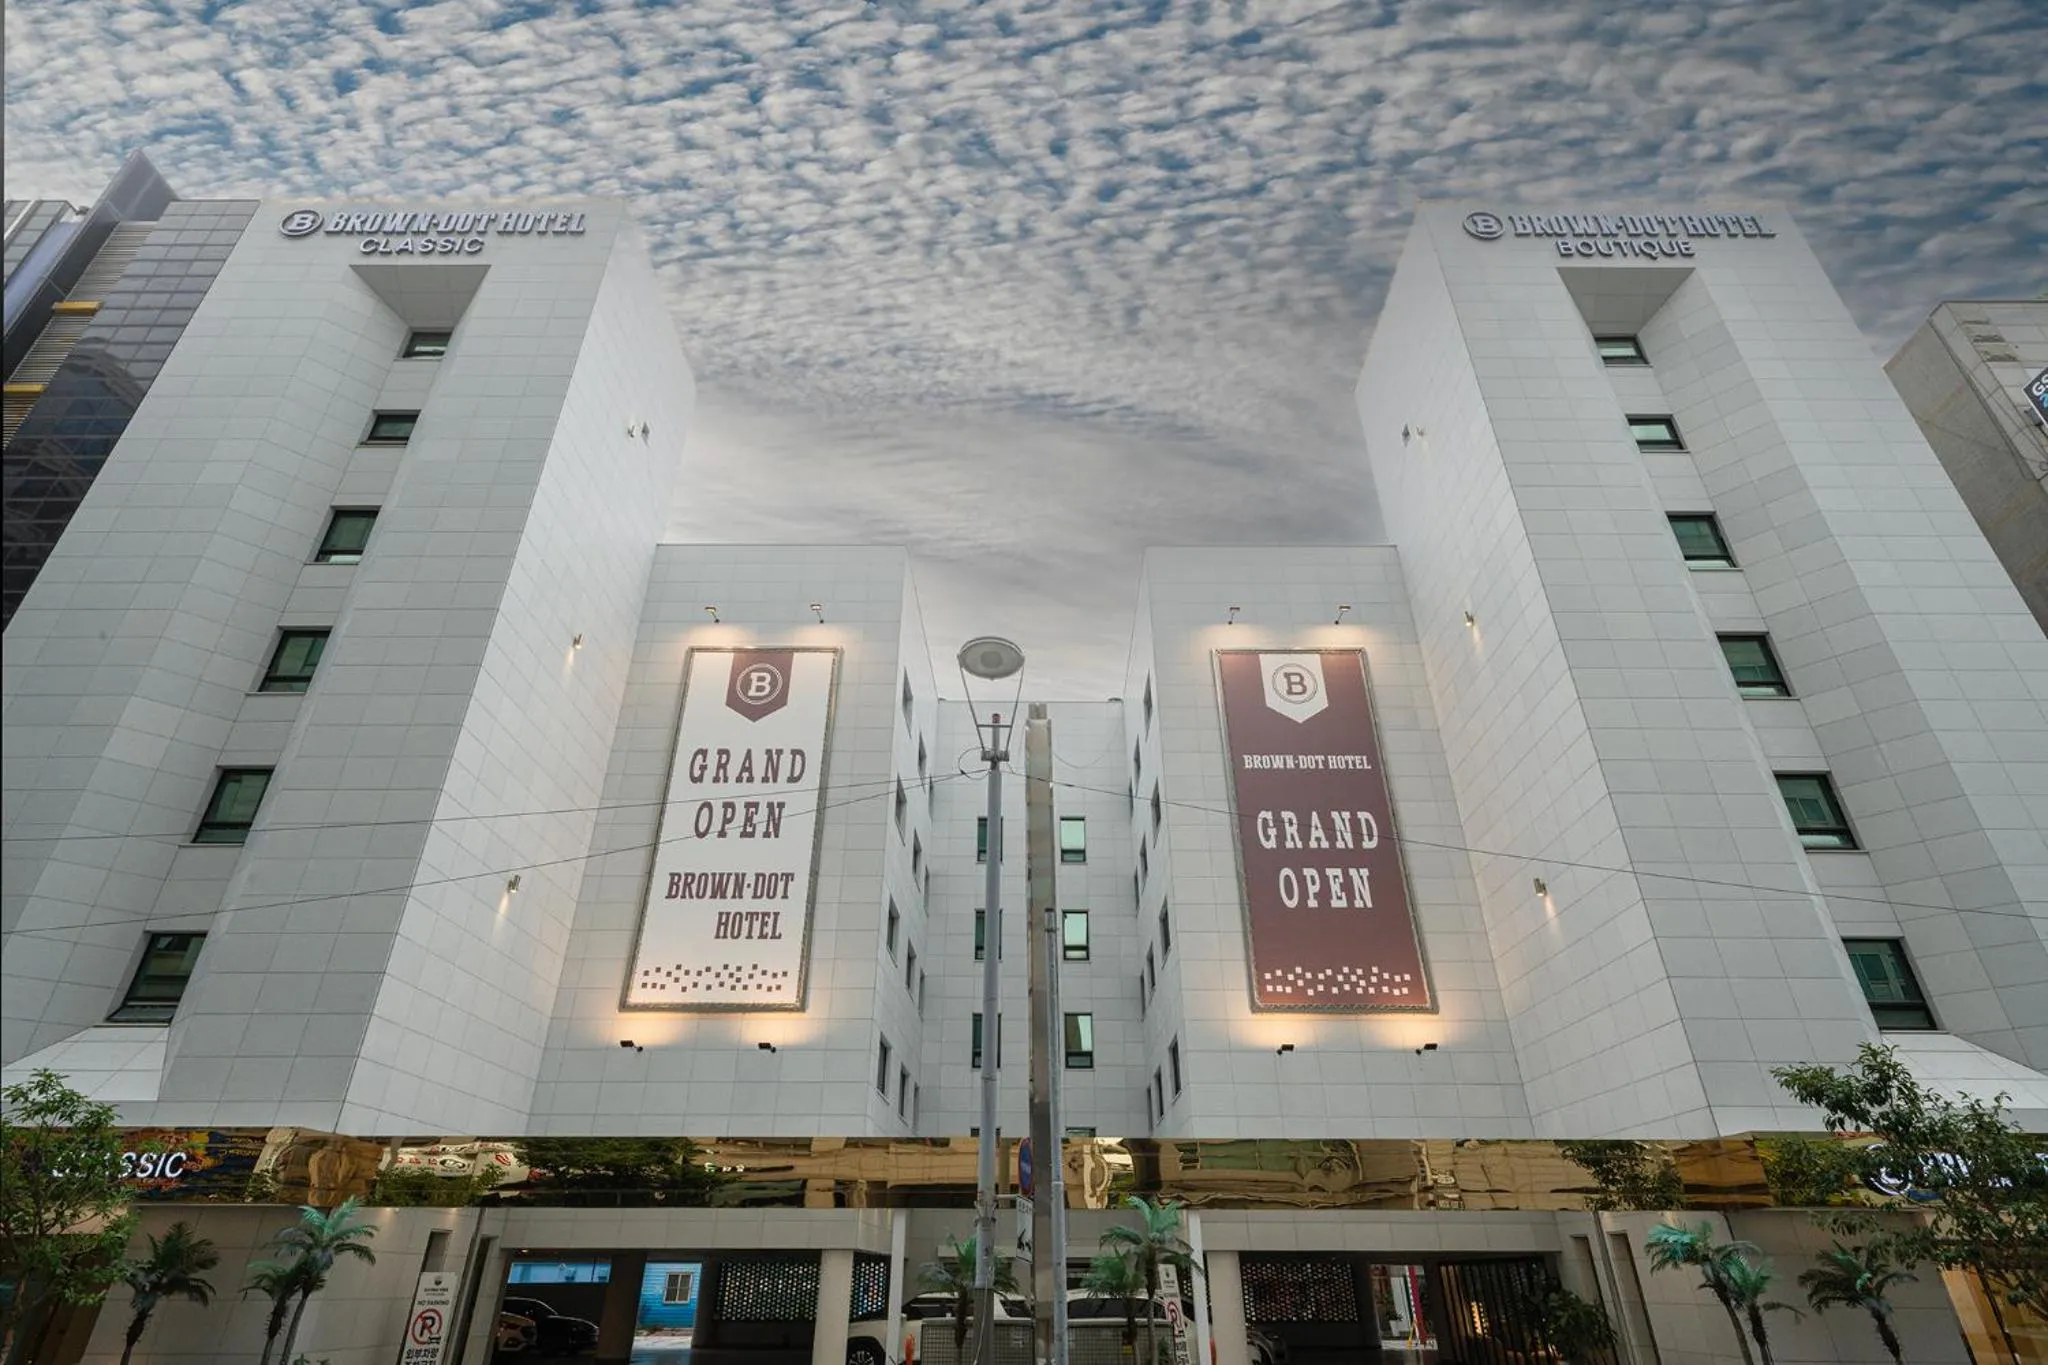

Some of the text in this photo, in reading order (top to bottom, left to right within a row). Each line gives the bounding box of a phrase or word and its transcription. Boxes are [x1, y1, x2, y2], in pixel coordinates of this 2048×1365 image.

[496, 212, 586, 235] HOTEL
[1682, 216, 1777, 239] HOTEL
[359, 237, 485, 255] CLASSIC
[1556, 240, 1696, 260] BOUTIQUE
[748, 671, 771, 697] B
[1283, 671, 1308, 696] B
[688, 748, 807, 784] GRAND
[1327, 754, 1372, 770] HOTEL
[694, 801, 786, 839] OPEN
[1256, 810, 1379, 850] GRAND
[1278, 867, 1374, 909] OPEN
[714, 911, 782, 940] HOTEL
[52, 1151, 187, 1178] SSIC
